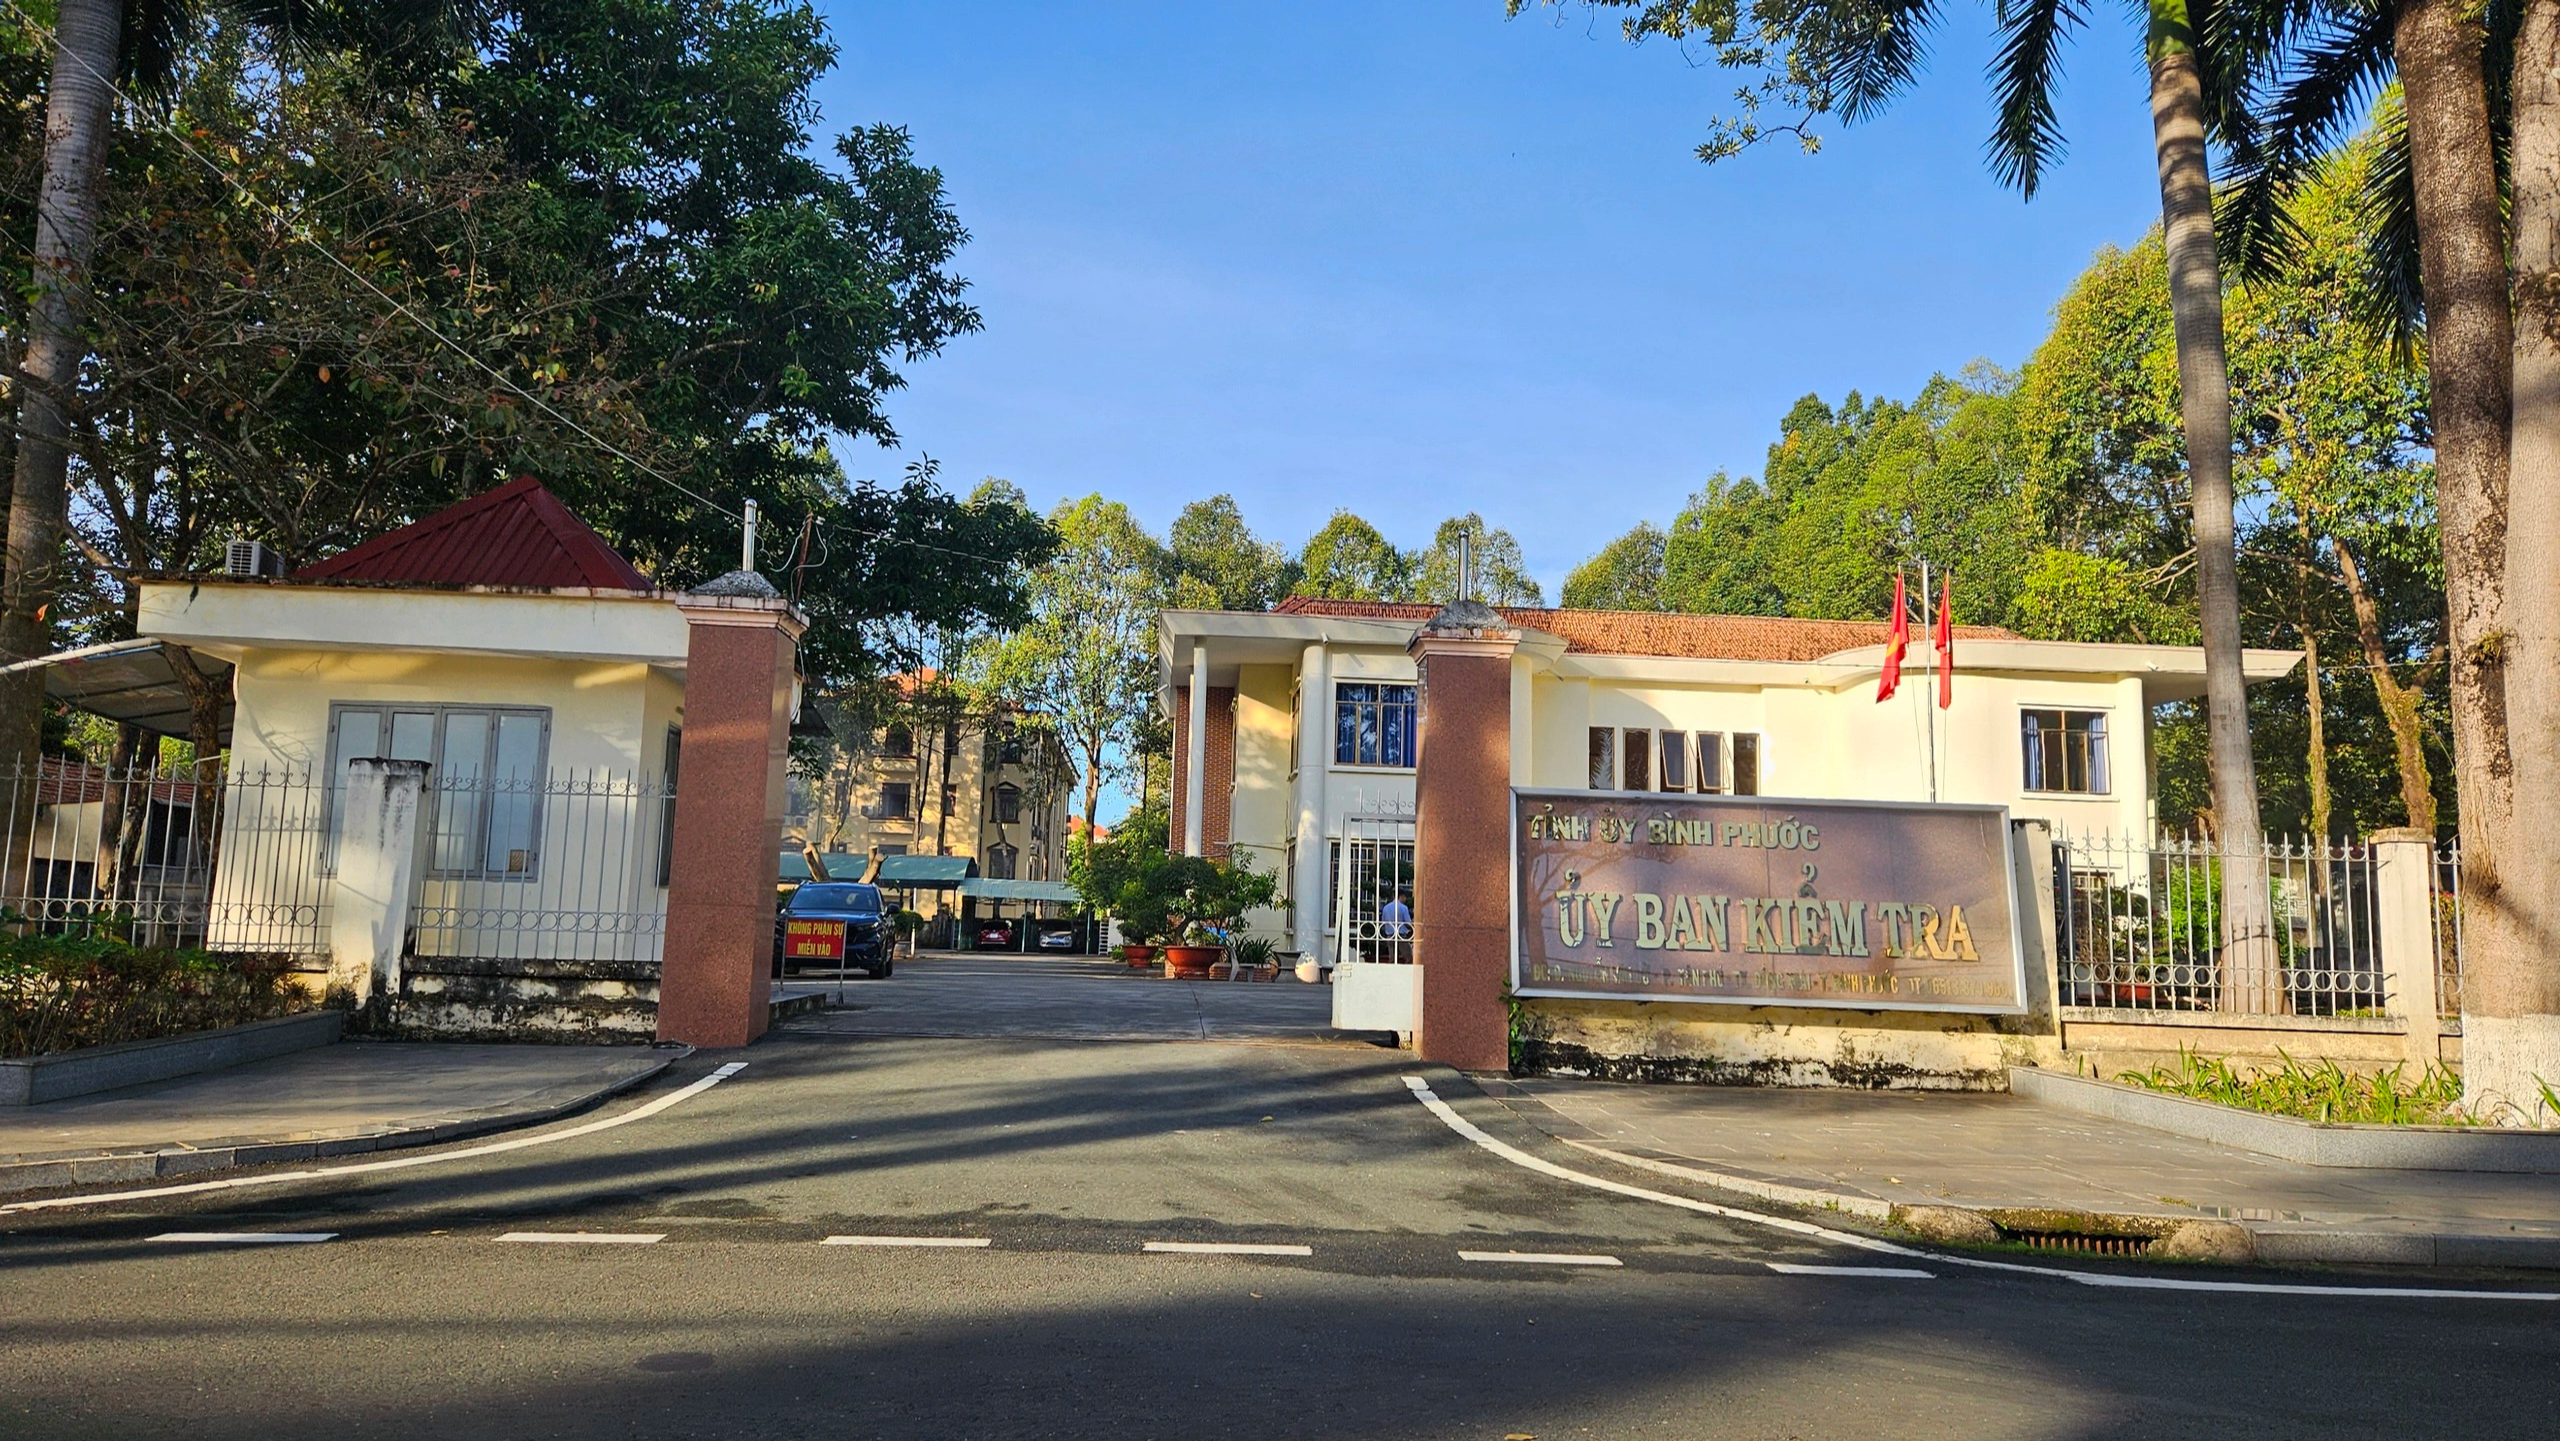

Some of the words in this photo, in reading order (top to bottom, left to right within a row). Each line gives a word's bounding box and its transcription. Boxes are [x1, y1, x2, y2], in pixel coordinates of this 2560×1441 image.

[1527, 804, 1592, 841] TỈNH
[1600, 807, 1638, 844] ỦY
[1648, 812, 1714, 847] BÌNH
[1720, 815, 1821, 851] PHƯỚC
[1556, 869, 1622, 949] ỦY
[1632, 892, 1730, 952] BAN
[1742, 862, 1871, 958] KIỂM
[1876, 904, 1980, 962] TRA
